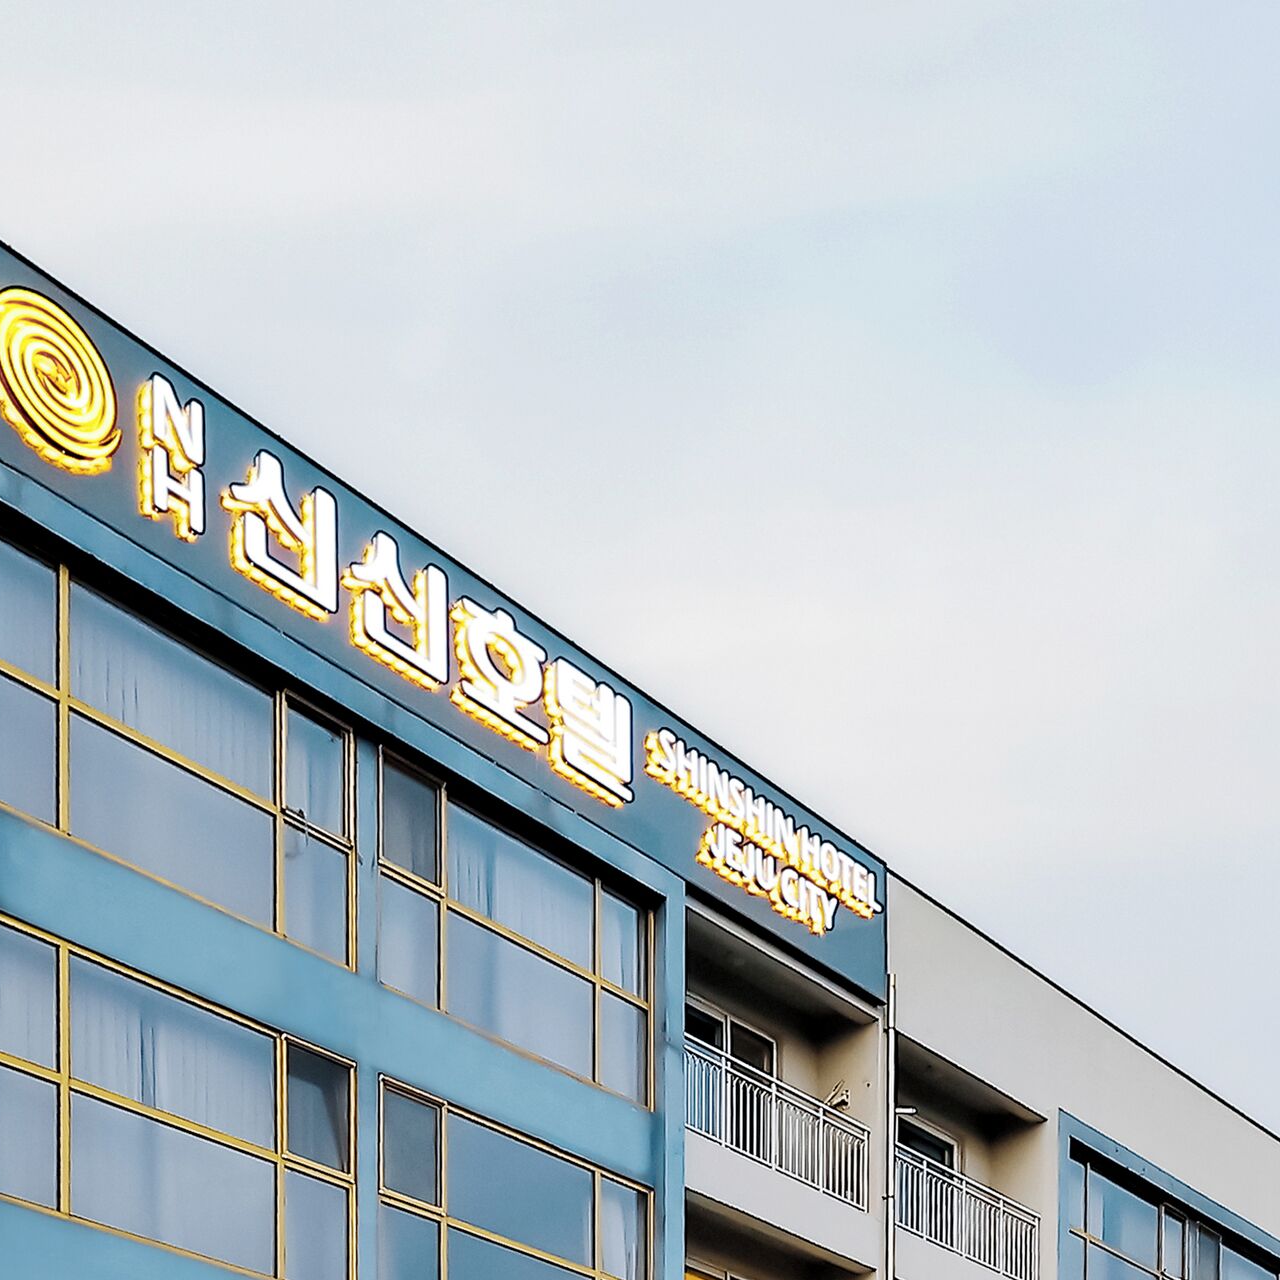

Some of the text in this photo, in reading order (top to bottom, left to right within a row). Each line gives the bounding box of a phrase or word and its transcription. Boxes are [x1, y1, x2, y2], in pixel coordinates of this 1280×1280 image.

[228, 448, 635, 804] 신신호텔
[656, 727, 884, 914] SHINSHIN HOTEL
[708, 822, 840, 932] JEJU CITY
